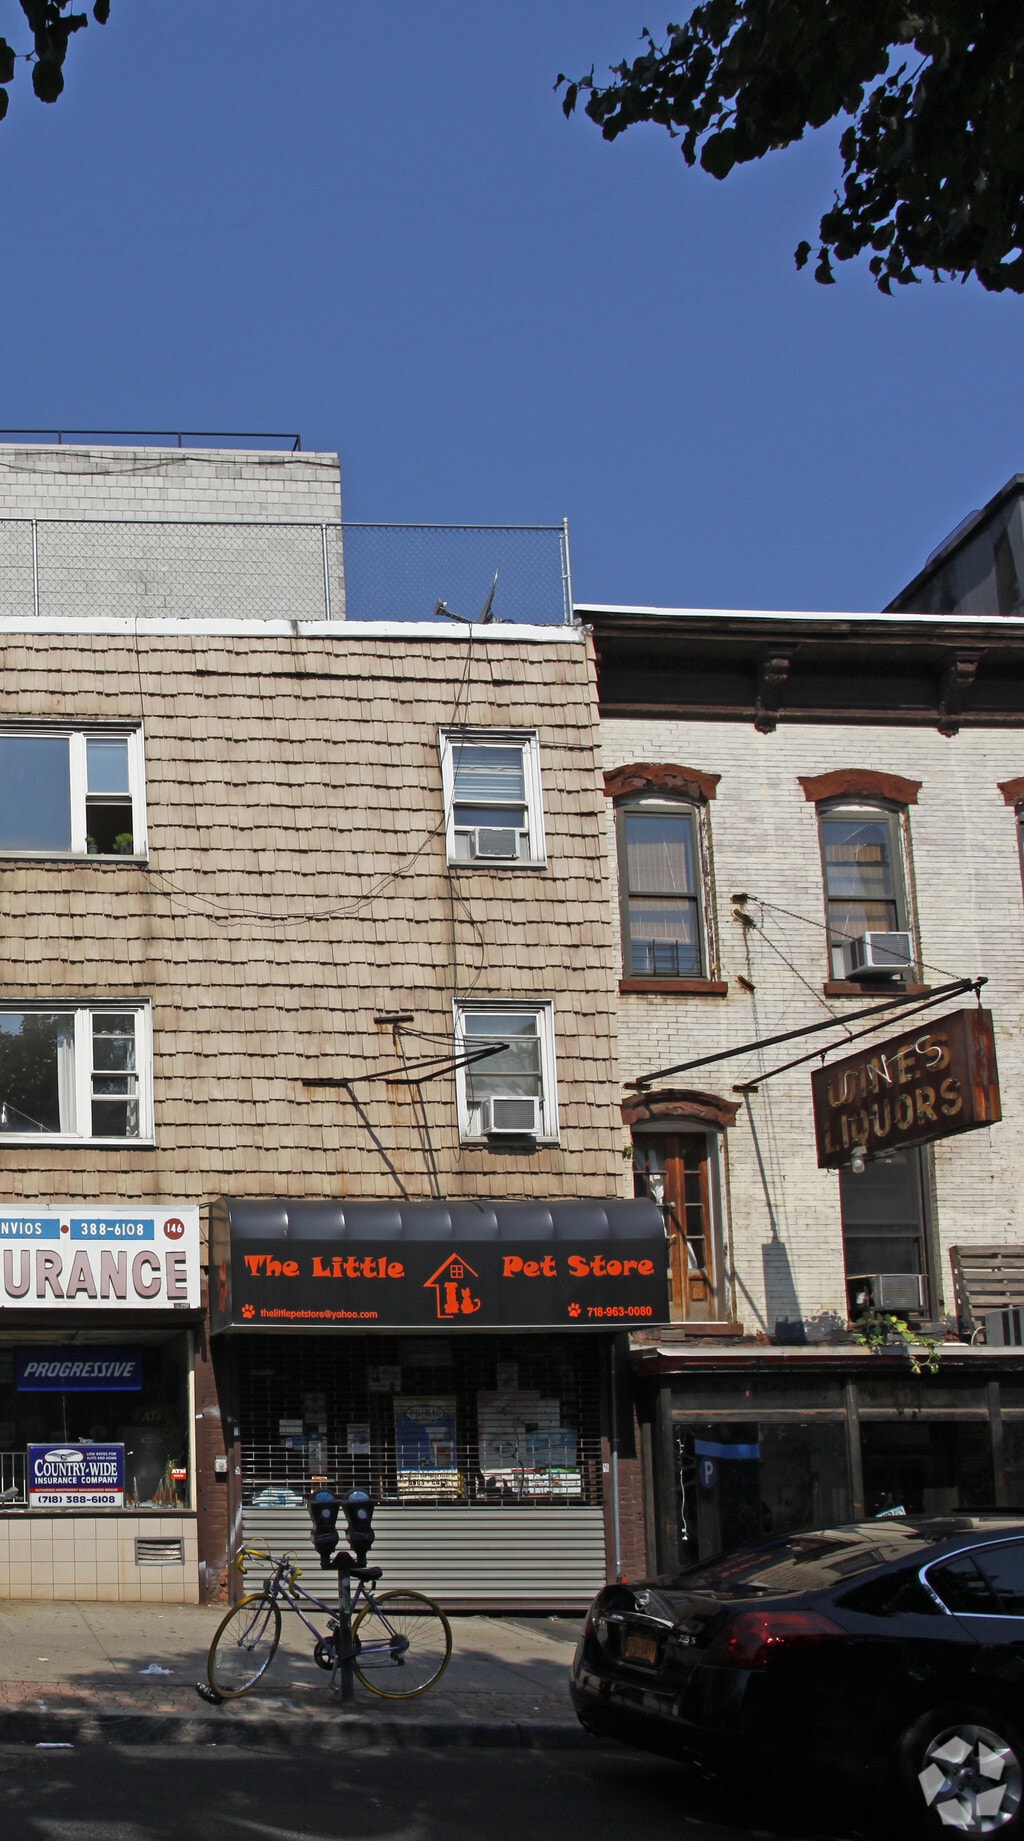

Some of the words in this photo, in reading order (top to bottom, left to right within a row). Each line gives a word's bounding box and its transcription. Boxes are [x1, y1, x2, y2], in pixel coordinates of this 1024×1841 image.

[828, 1031, 951, 1108] WINES
[825, 1077, 963, 1152] LIQUORS
[81, 1222, 144, 1236] 388-6108
[166, 1223, 182, 1233] 146
[244, 1255, 300, 1277] The
[312, 1256, 405, 1279] Little
[502, 1255, 557, 1277] Pet
[567, 1255, 655, 1277] Store
[260, 1309, 378, 1320] thelittlepetstore@yahoo.com
[587, 1306, 653, 1317] 718-963-0080
[24, 1362, 136, 1377] PROGRESSIVE
[34, 1459, 118, 1477] COUNTRY-WIDE
[704, 1461, 713, 1484] P
[35, 1477, 77, 1485] INSURANCE
[38, 1496, 62, 1504] (718)
[66, 1496, 115, 1504] 388-6108
